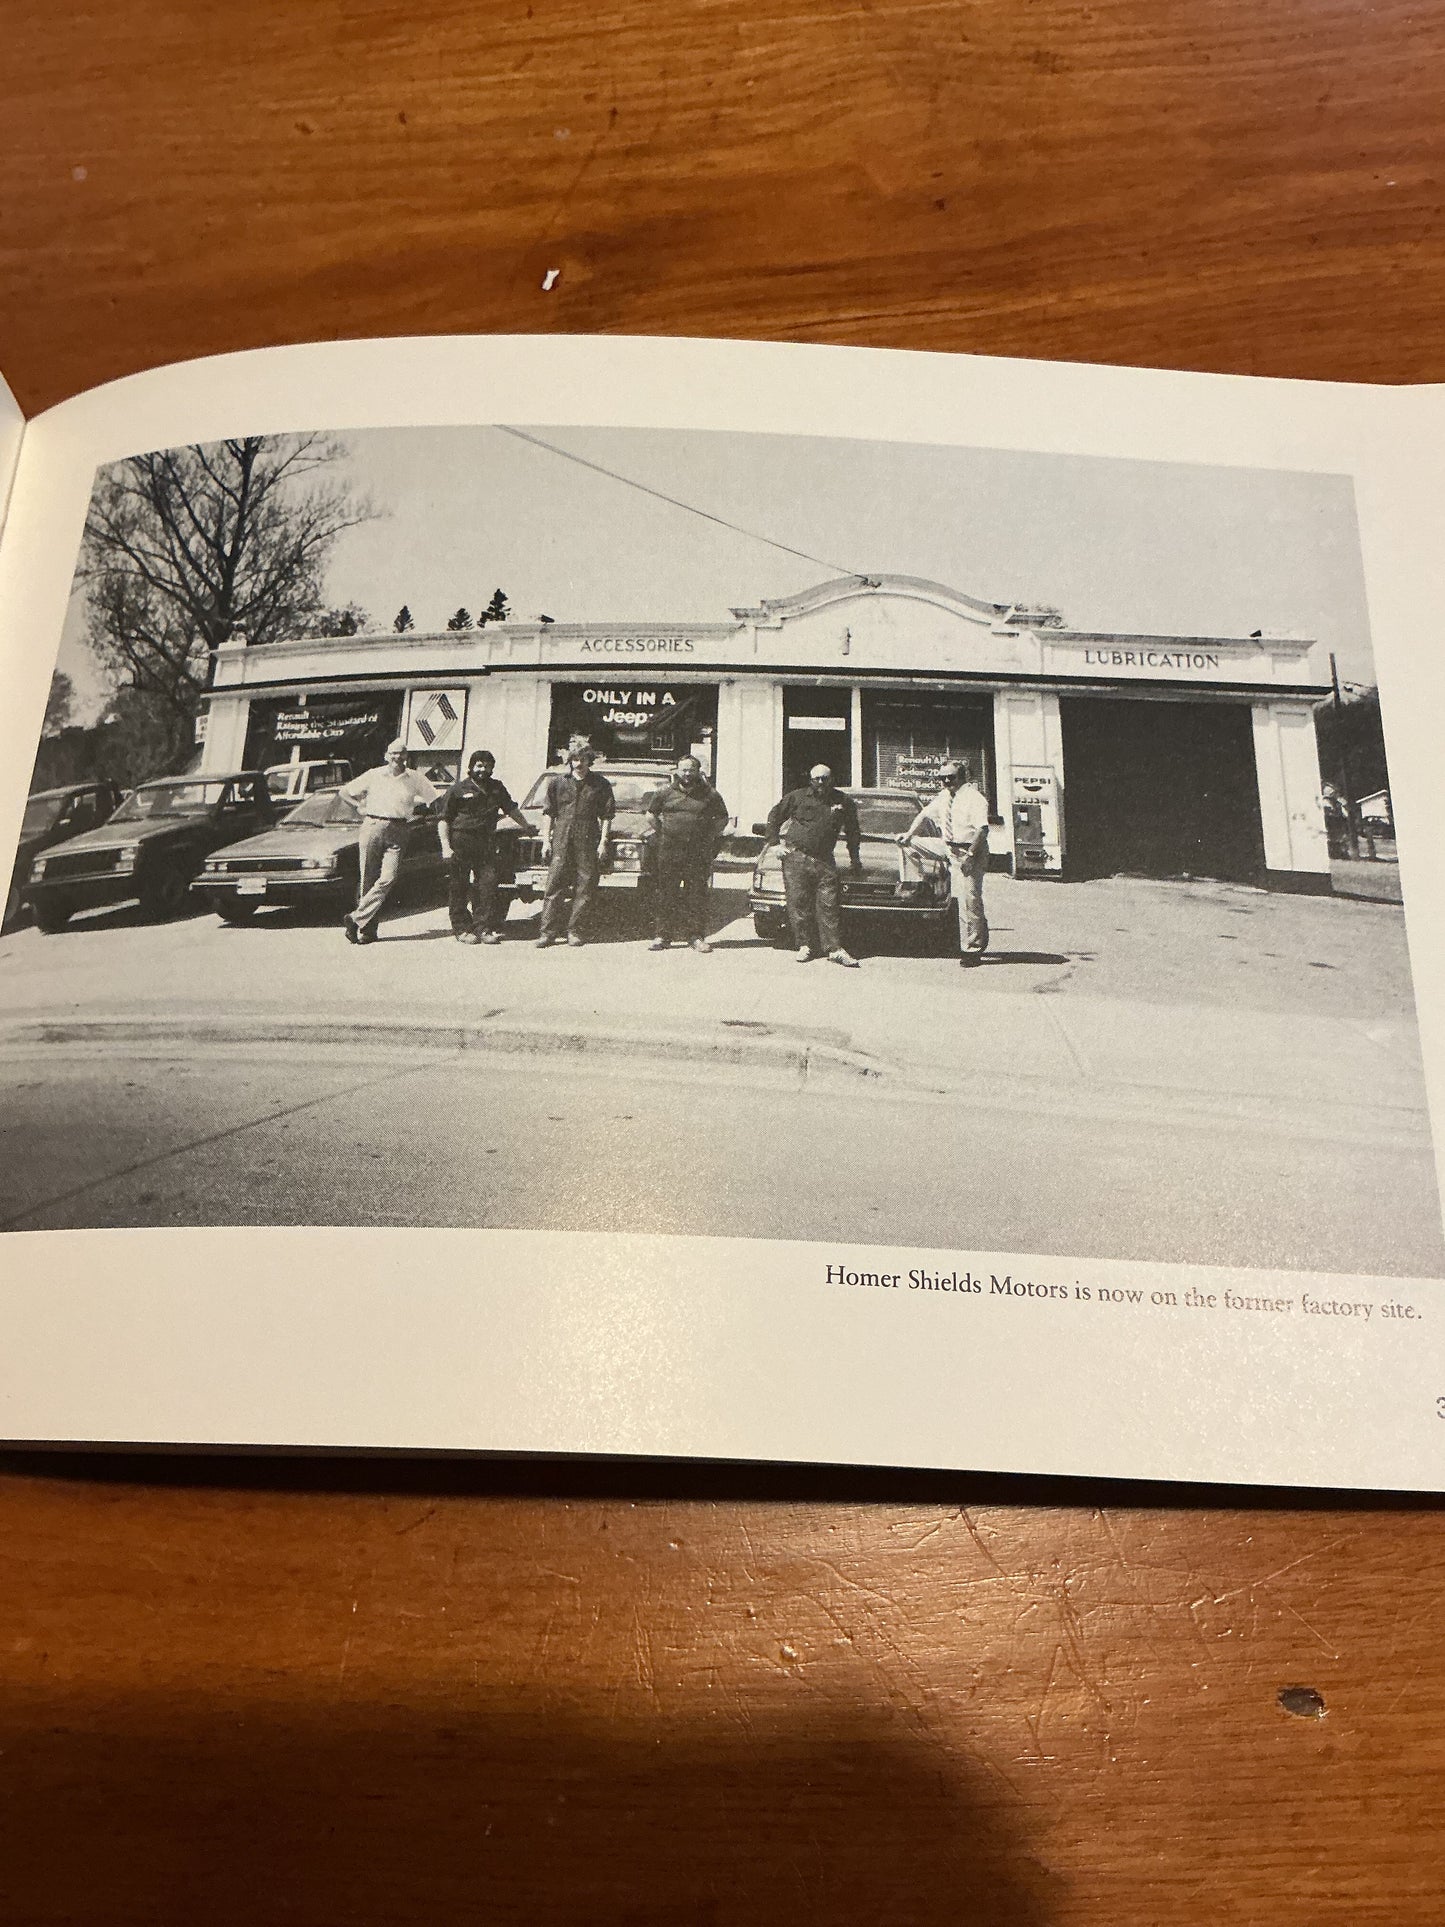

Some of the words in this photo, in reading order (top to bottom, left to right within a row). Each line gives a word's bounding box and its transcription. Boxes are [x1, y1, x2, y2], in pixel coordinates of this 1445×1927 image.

[580, 638, 694, 653] ACCESSORIES
[1085, 650, 1219, 668] LUBRICATION
[582, 689, 631, 704] ONLY
[636, 691, 656, 705] IN
[661, 692, 676, 705] A
[602, 708, 648, 727] Jeep
[1014, 776, 1052, 785] PEPSI
[826, 1265, 900, 1288] Homer
[908, 1270, 982, 1294] Shields
[989, 1275, 1068, 1299] Motors
[1075, 1280, 1091, 1300] is
[1098, 1288, 1143, 1304] now
[1151, 1290, 1177, 1306] on
[1184, 1287, 1217, 1308] the
[1224, 1288, 1293, 1312] former
[1302, 1294, 1373, 1321] factory
[1382, 1299, 1423, 1320] site.
